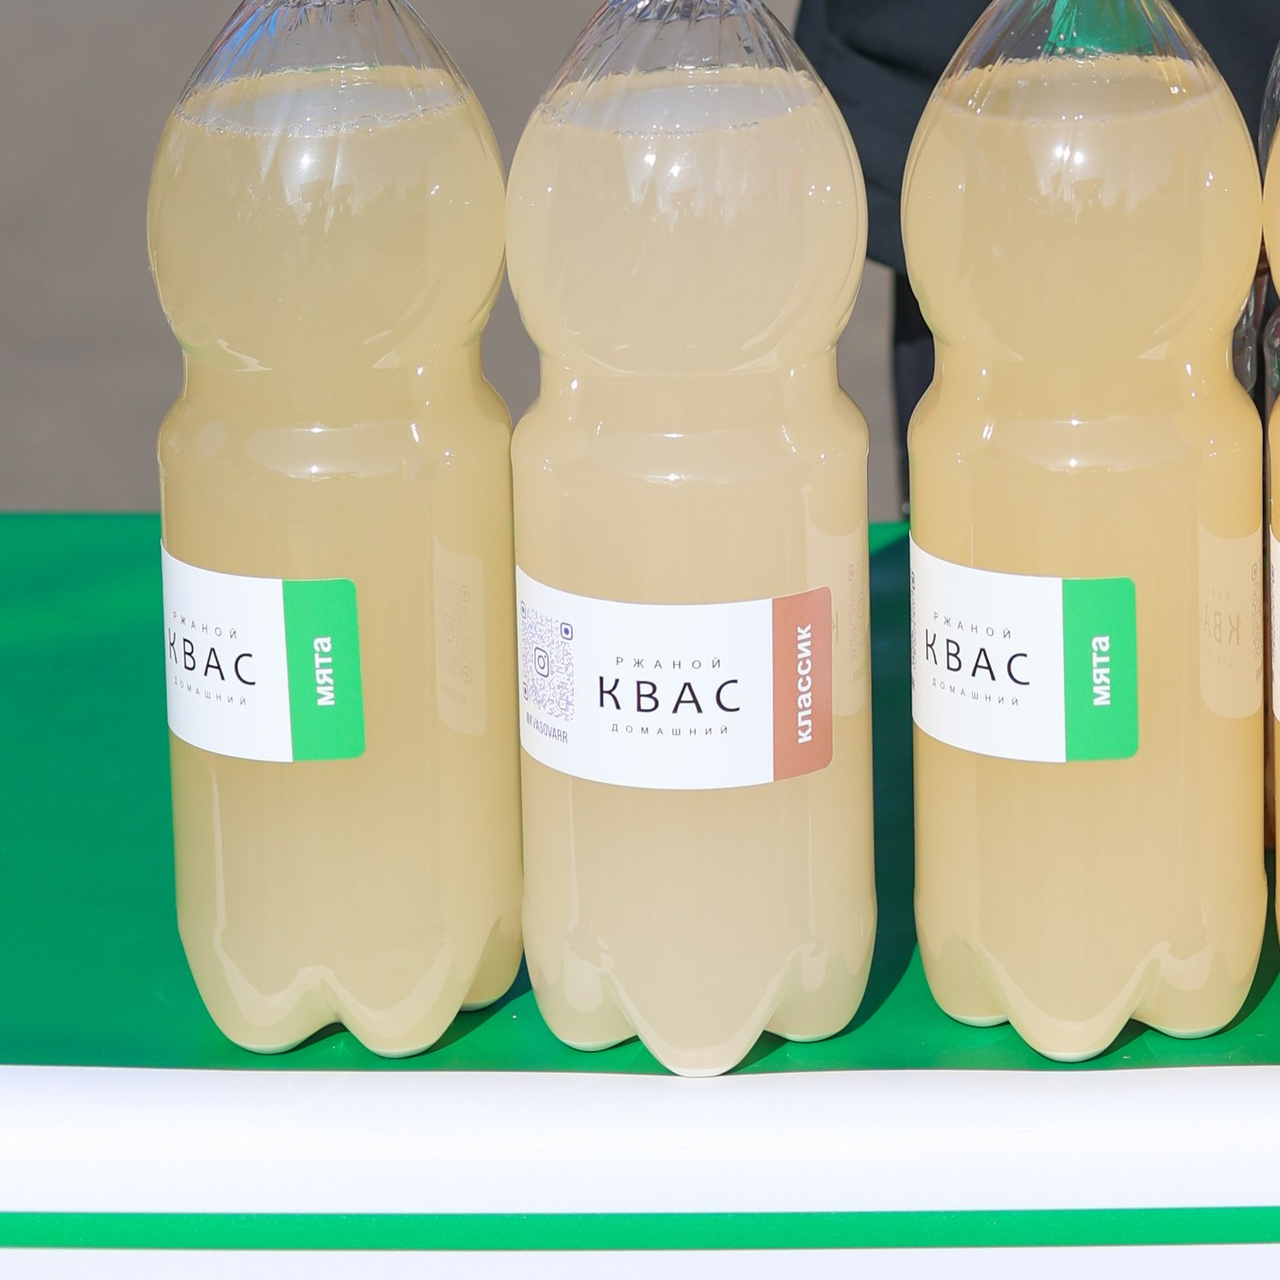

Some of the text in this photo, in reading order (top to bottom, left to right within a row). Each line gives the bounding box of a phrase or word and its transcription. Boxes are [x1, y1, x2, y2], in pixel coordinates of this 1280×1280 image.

[172, 611, 238, 640] РЖАНОЙ
[933, 611, 1011, 640] РЖАНОЙ
[168, 627, 256, 686] КВАС
[313, 636, 335, 707] мята
[615, 656, 721, 670] РЖАНОЙ
[925, 628, 1030, 686] КВАС
[1091, 635, 1111, 707] мята
[173, 676, 248, 707] ДОМАШНИЙ
[598, 675, 741, 715] КВАС
[797, 623, 812, 744] классик
[932, 677, 1019, 707] ДОМАШНИЙ
[611, 723, 728, 736] ДОМАШНИЙ
